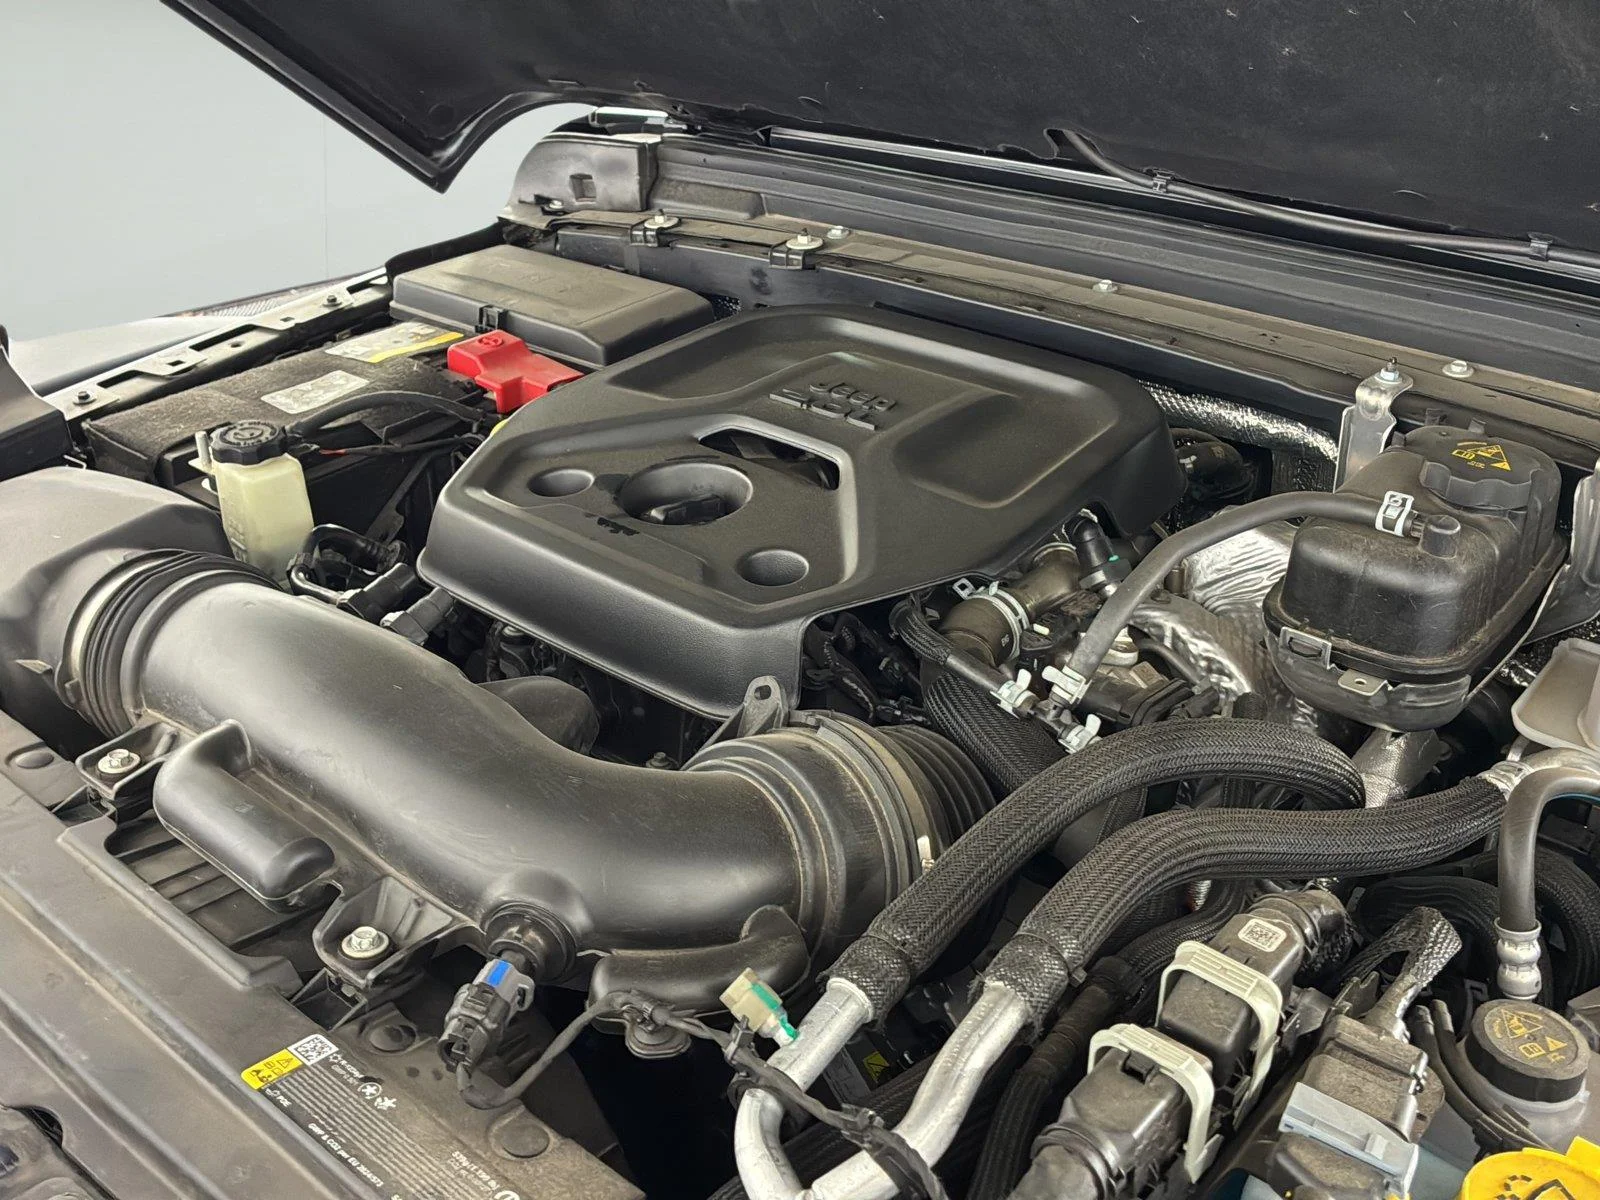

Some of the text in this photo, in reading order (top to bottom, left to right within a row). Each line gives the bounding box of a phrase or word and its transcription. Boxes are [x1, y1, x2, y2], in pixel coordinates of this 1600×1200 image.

[308, 1122, 325, 1135] GWP
[337, 1150, 350, 1159] per
[347, 1157, 360, 1166] EU
